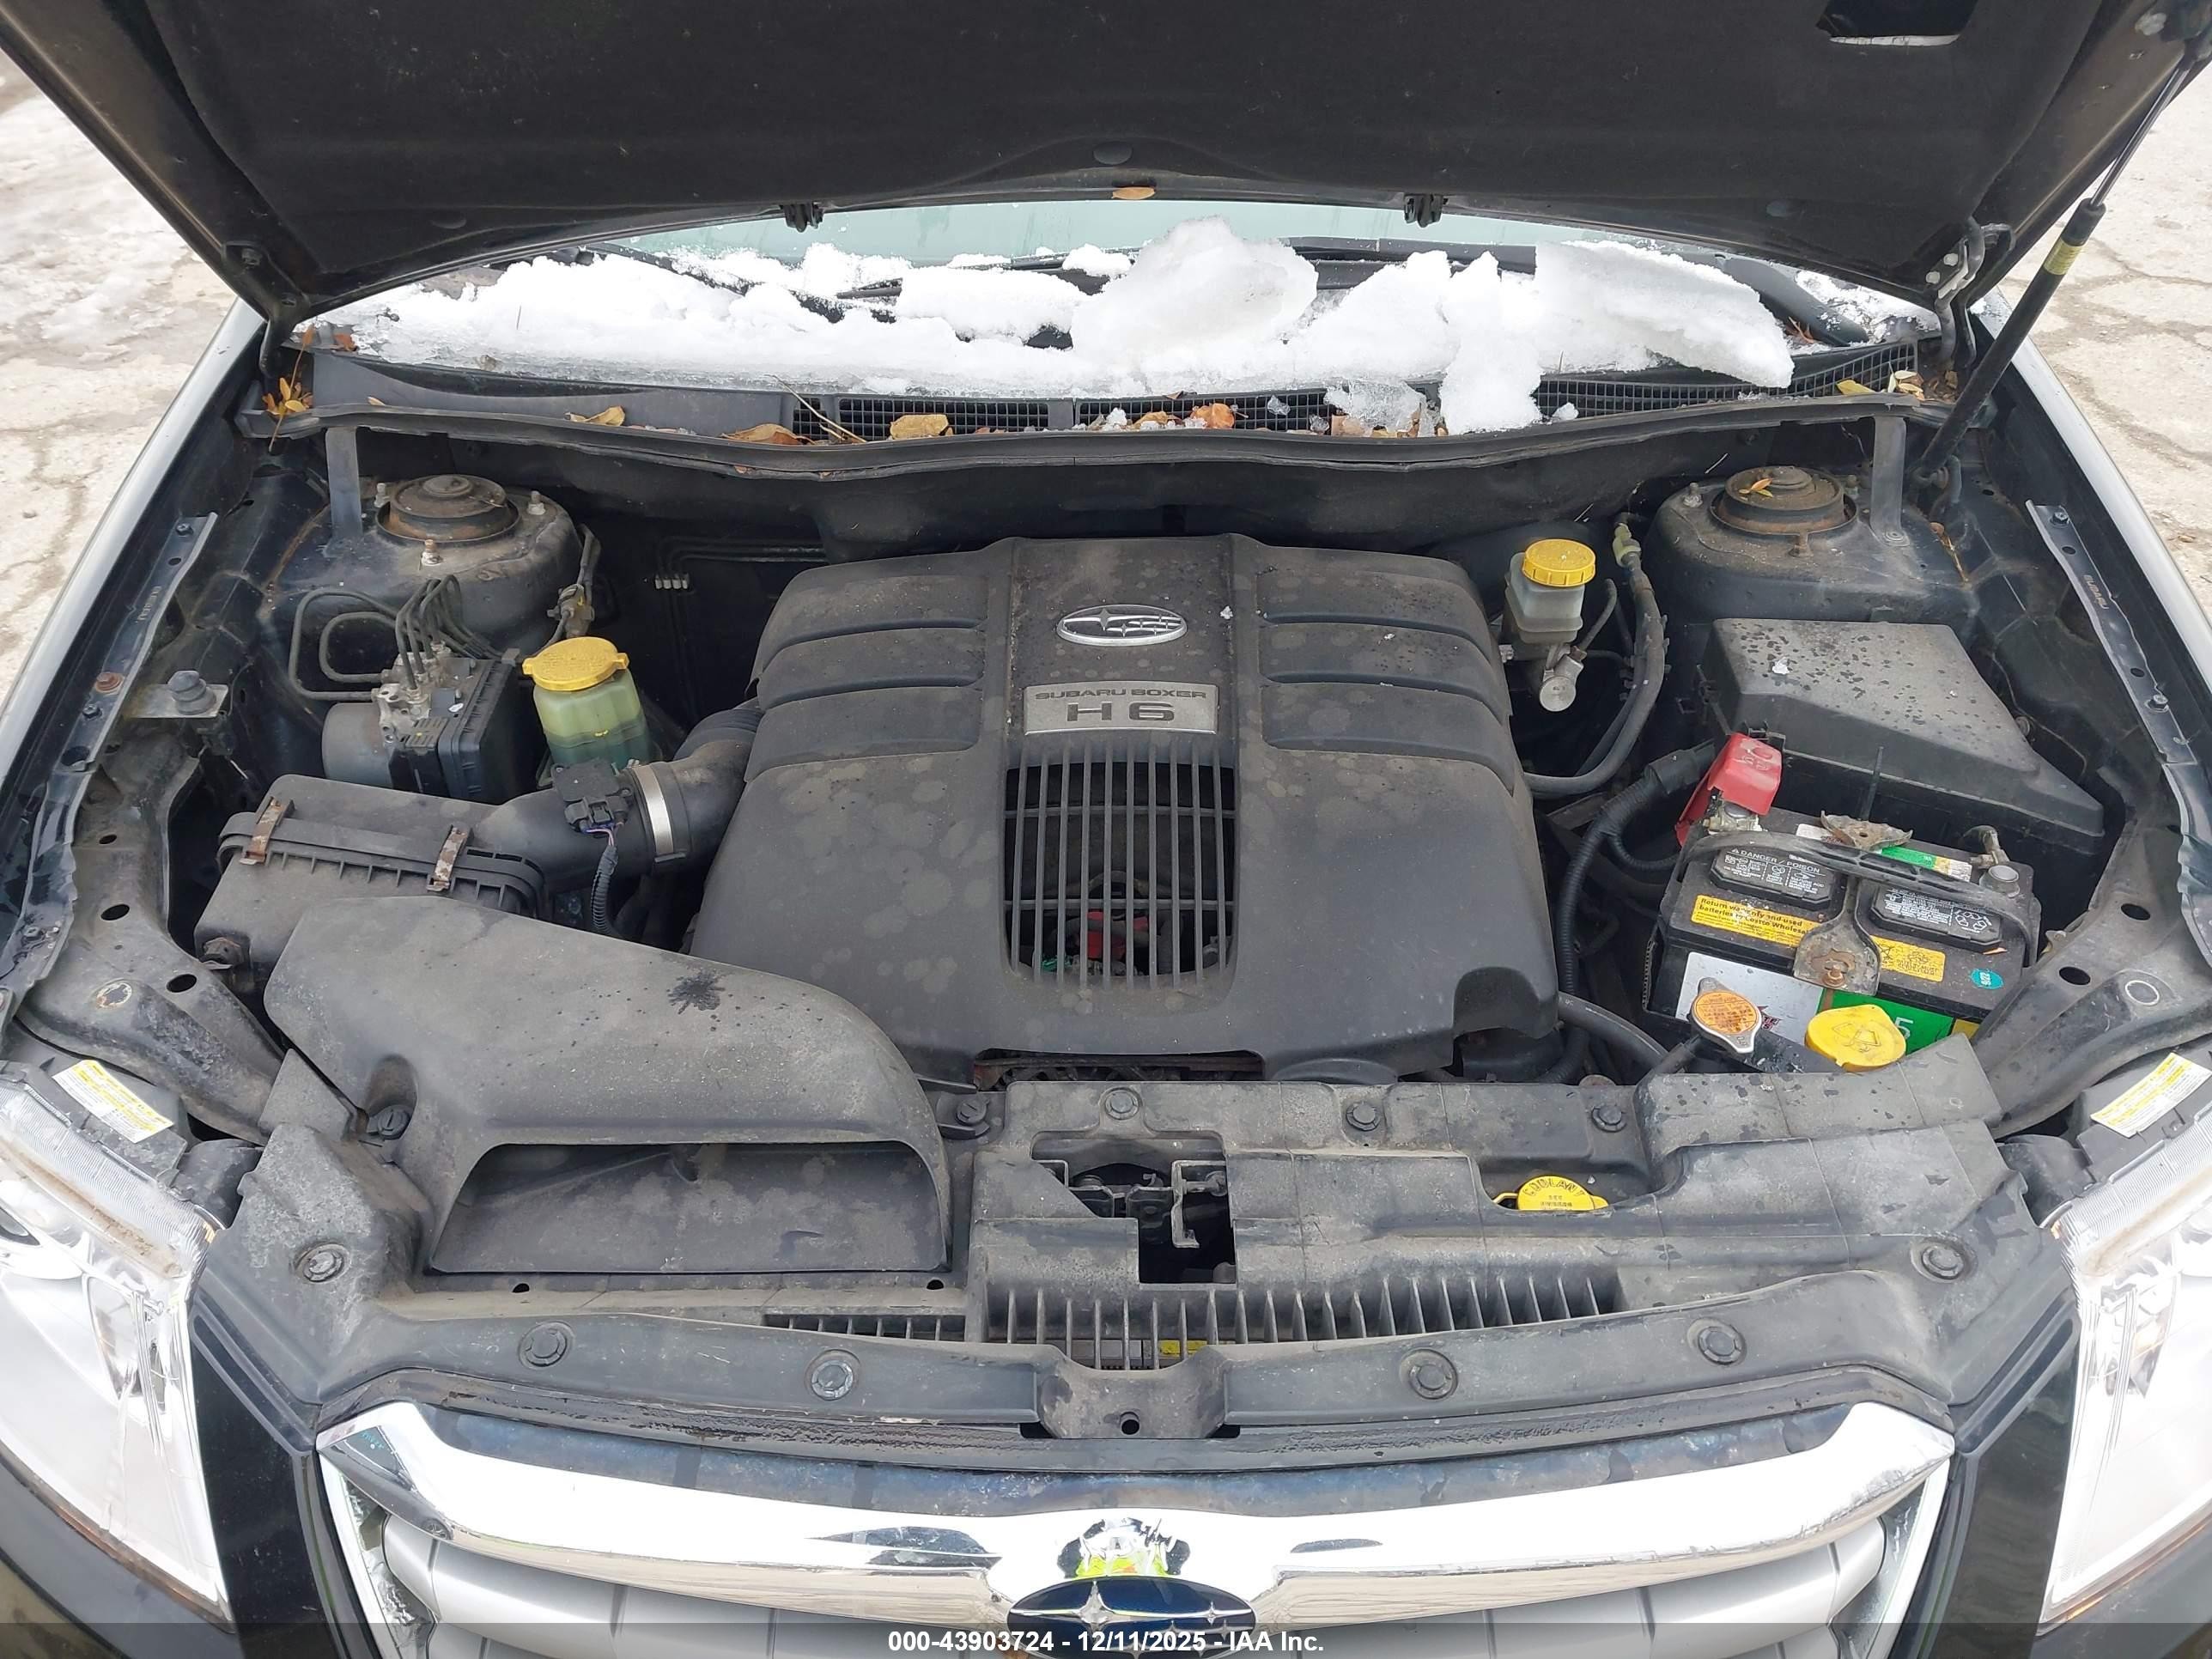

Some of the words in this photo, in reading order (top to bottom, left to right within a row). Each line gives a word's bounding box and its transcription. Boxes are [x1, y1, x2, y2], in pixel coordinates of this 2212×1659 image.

[1035, 689, 1127, 700] SUBARU
[1131, 689, 1206, 698] BOXER
[1066, 701, 1176, 722] H6
[1740, 850, 1778, 863] DANGER
[1787, 860, 1820, 873] POISON
[1701, 897, 1728, 910] Return
[1699, 903, 1734, 917] batteries
[1771, 921, 1808, 935] Wholesa
